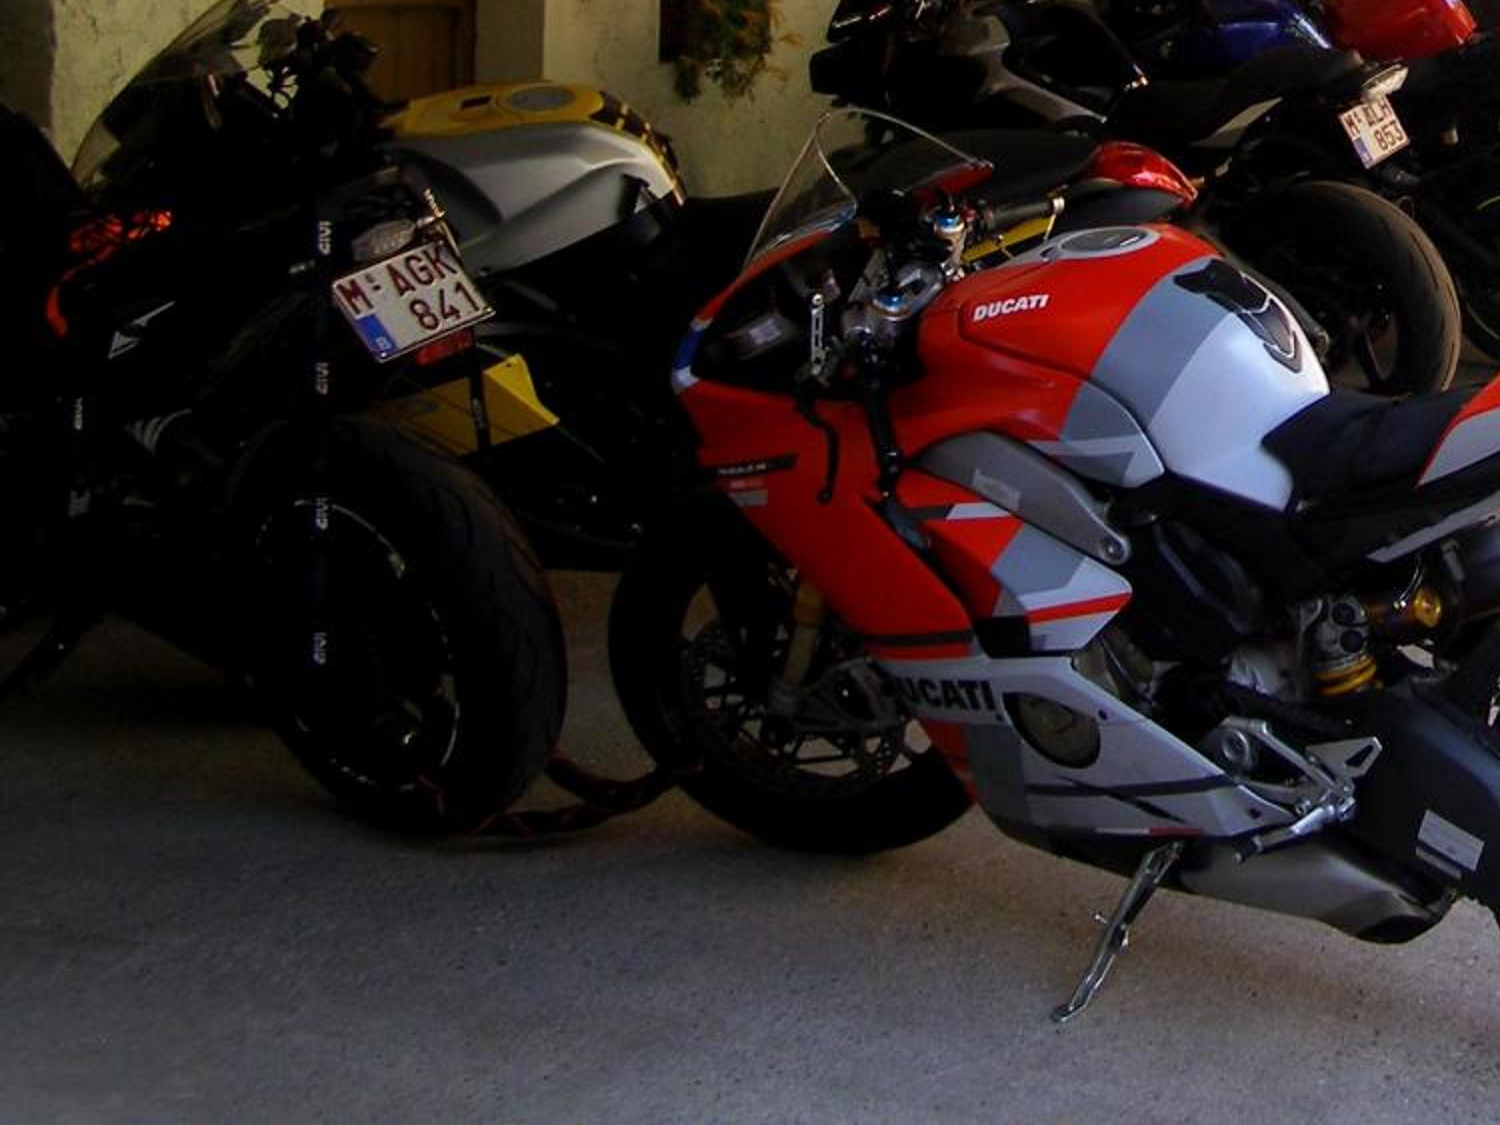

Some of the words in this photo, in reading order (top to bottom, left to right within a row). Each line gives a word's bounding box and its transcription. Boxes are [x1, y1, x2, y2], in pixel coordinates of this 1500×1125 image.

[1373, 120, 1404, 150] 853
[318, 220, 331, 255] GIVI
[409, 281, 480, 331] 841
[973, 293, 1049, 322] DUCATI
[315, 362, 329, 395] GIVI
[890, 676, 996, 711] UCATI
